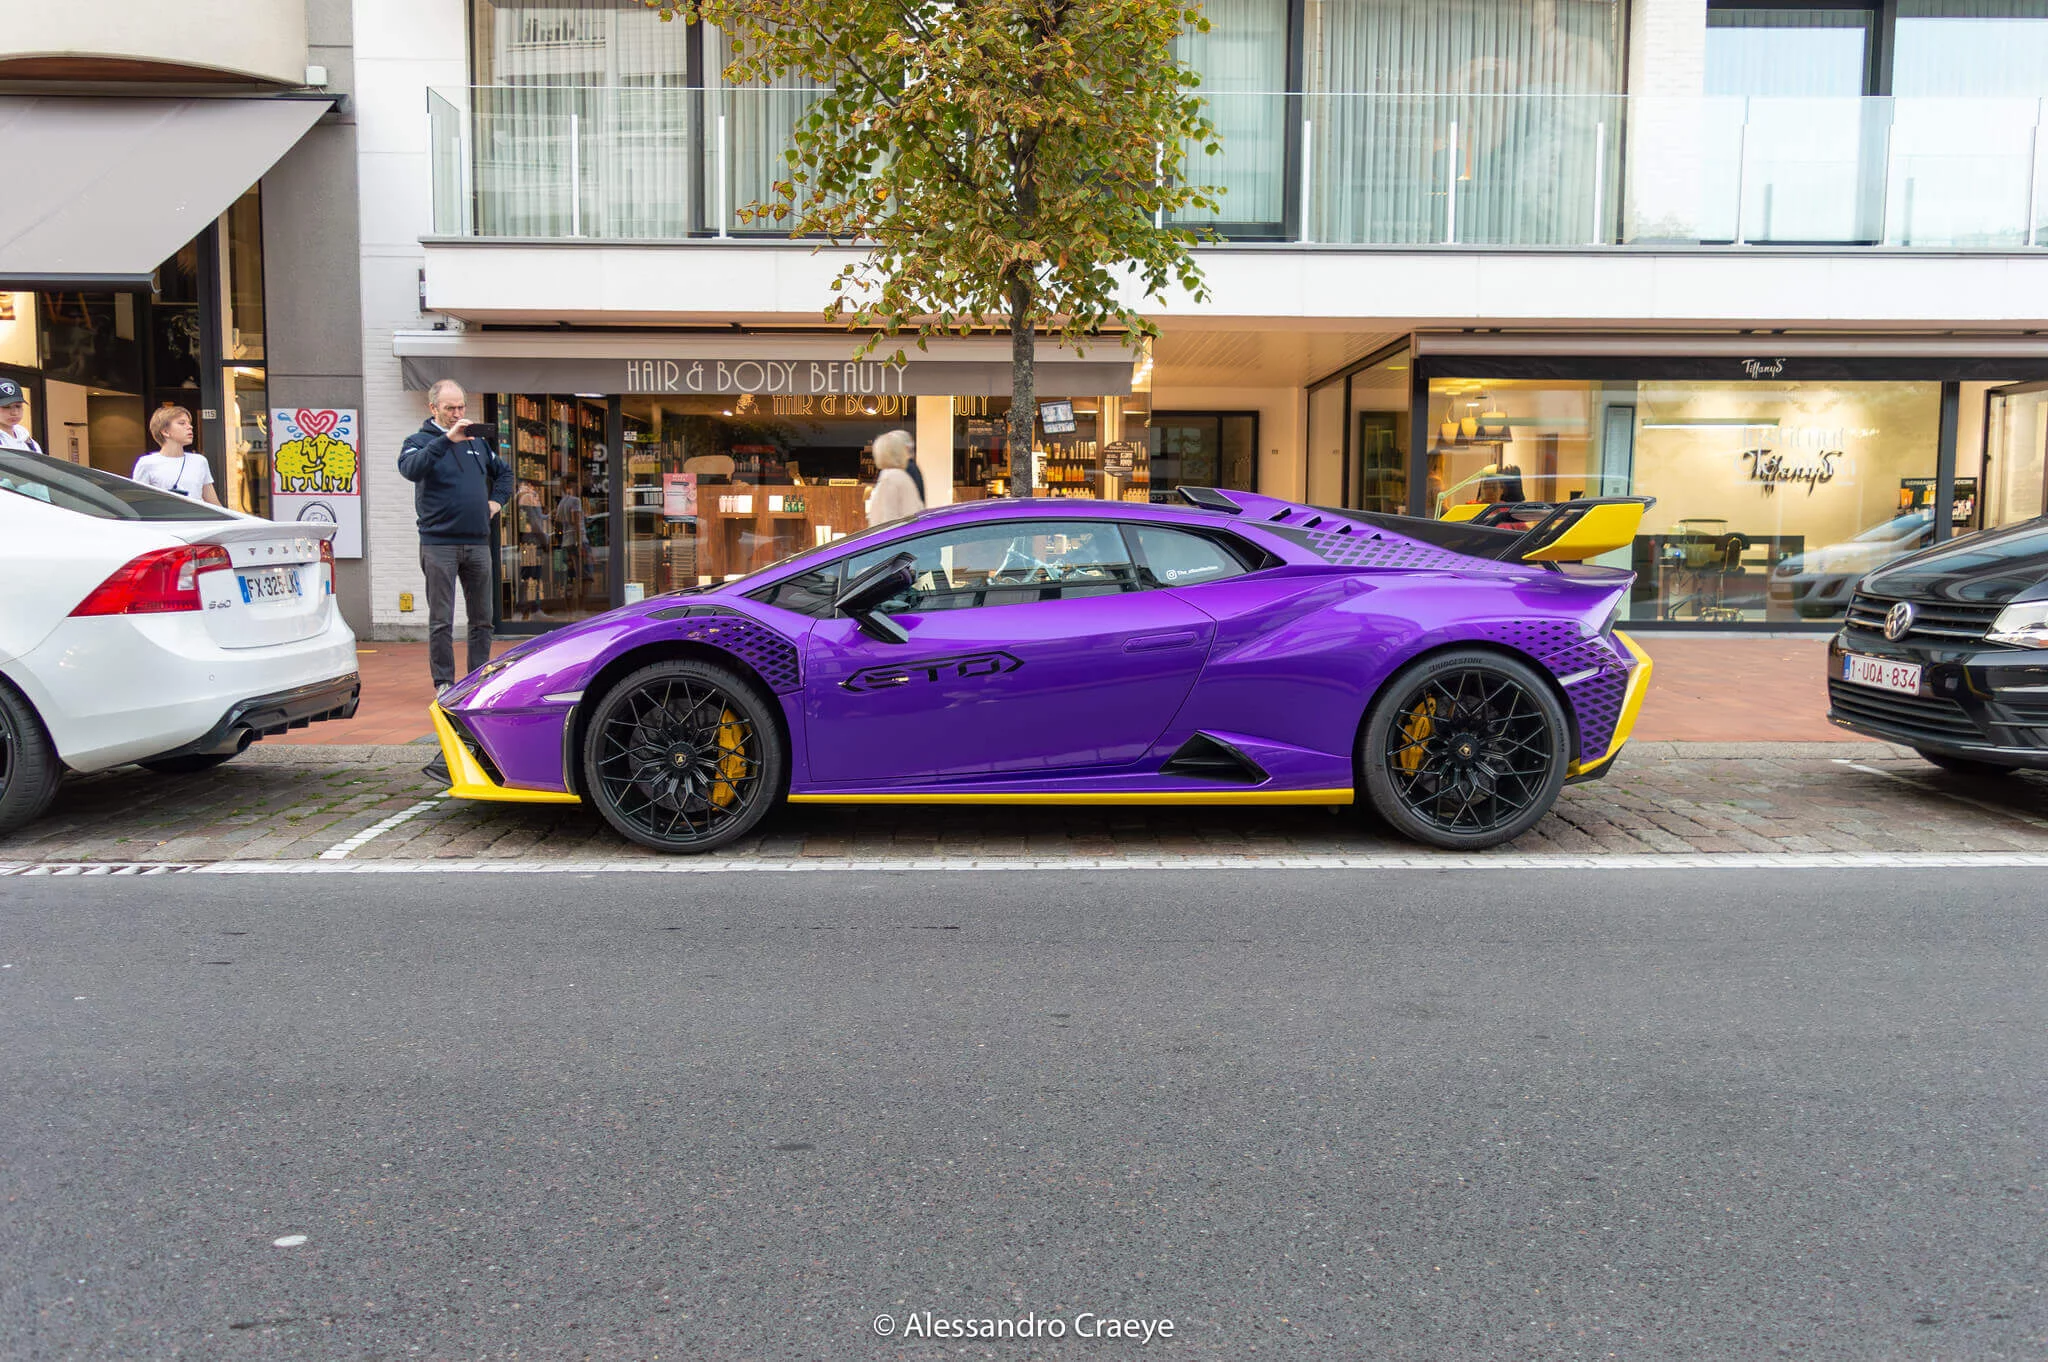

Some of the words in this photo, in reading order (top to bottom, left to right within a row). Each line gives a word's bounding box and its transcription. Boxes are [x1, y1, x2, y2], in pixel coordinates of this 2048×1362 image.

[627, 360, 679, 392] HAIR
[686, 360, 704, 392] &
[717, 360, 797, 392] BODY
[810, 361, 909, 393] BEAUTY
